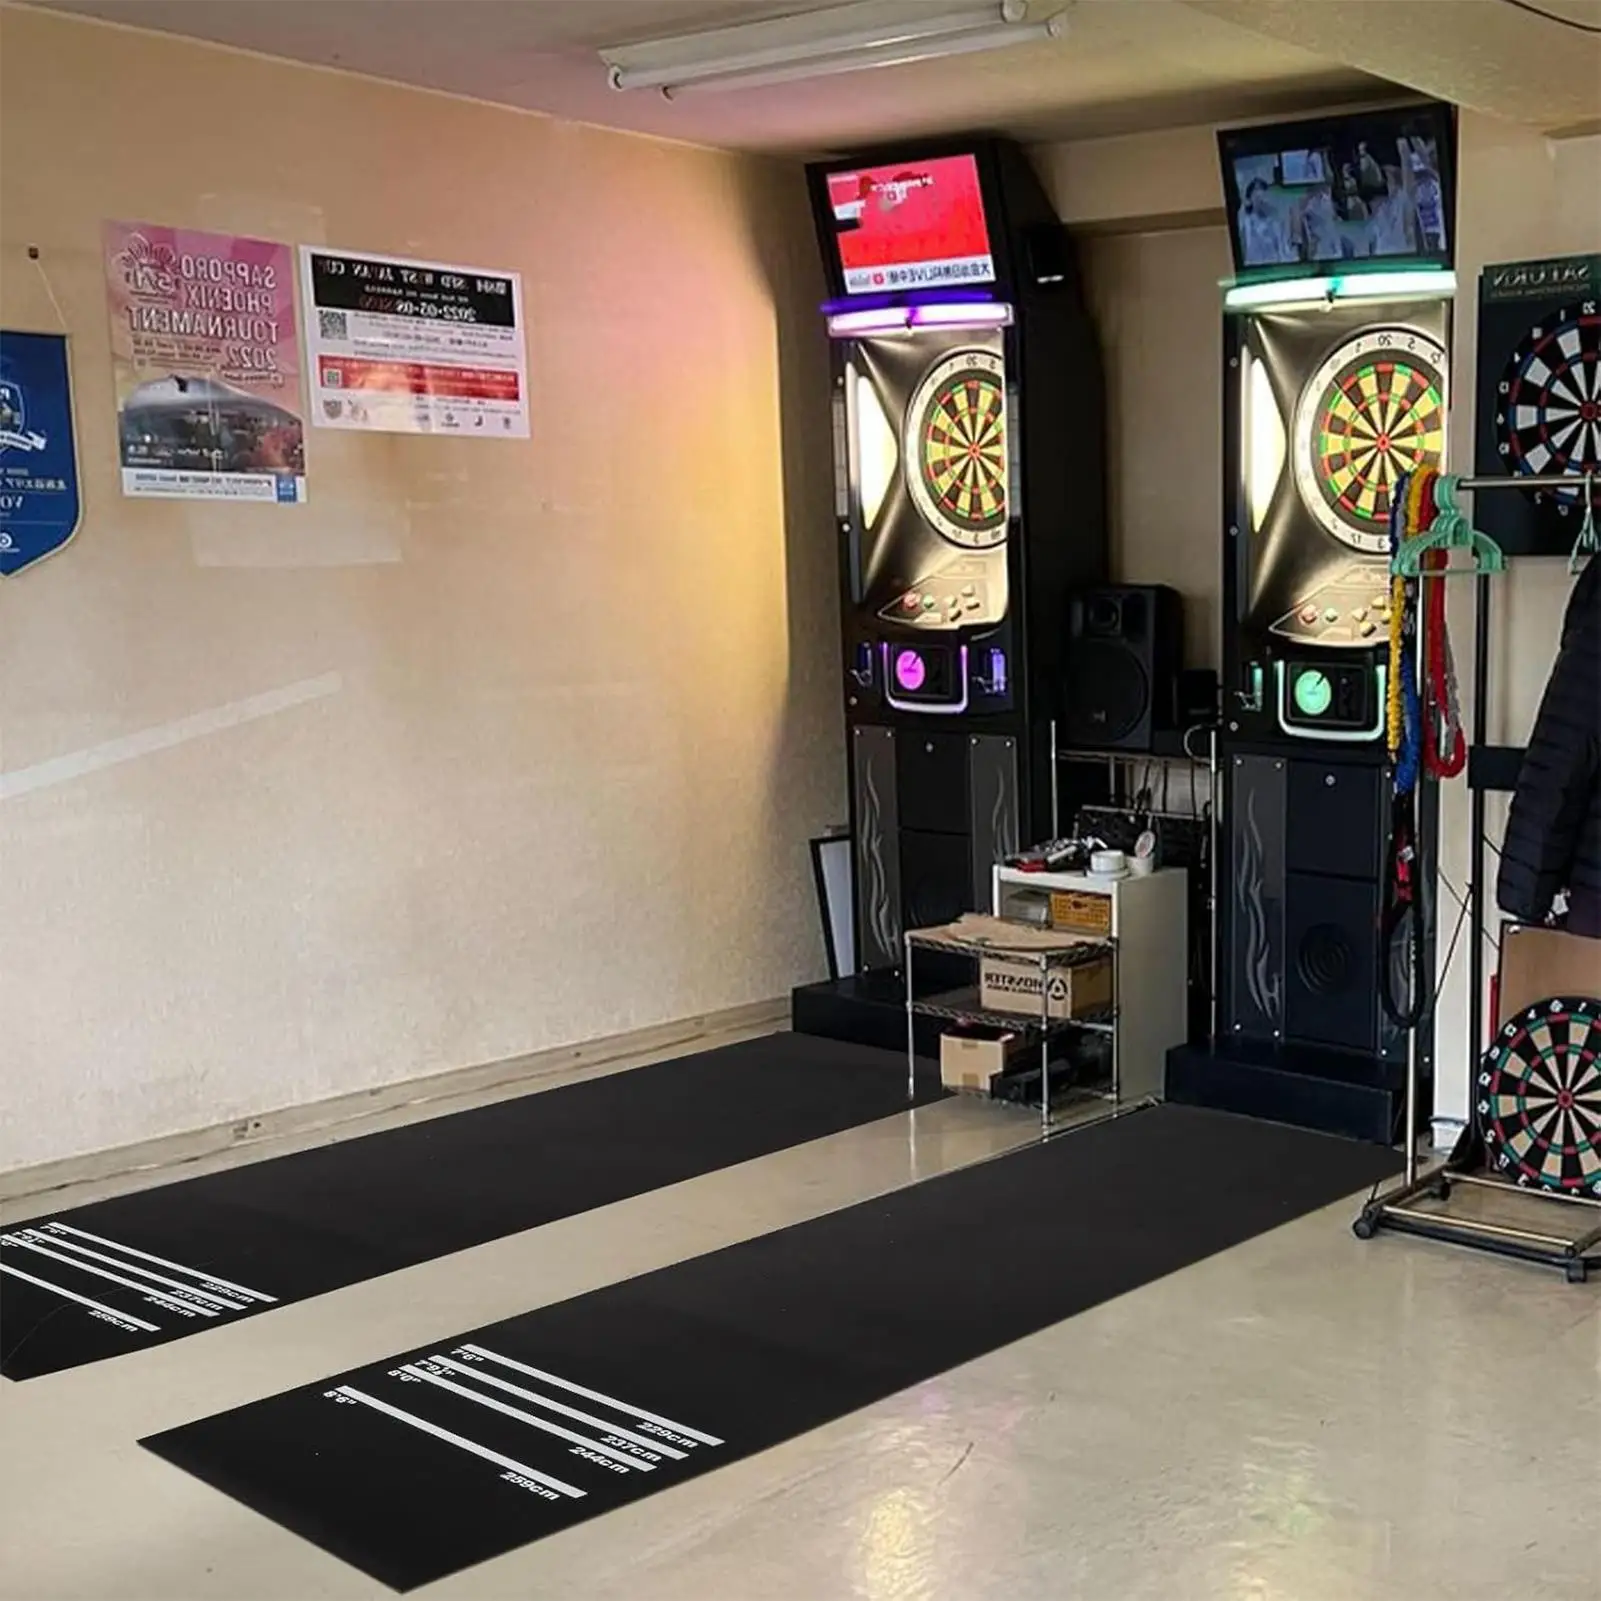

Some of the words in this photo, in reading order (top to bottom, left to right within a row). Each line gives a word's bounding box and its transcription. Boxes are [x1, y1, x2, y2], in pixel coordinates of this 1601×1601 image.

[170, 1289, 225, 1311] 237cm
[600, 1434, 662, 1462] 237cm
[635, 1421, 699, 1448] 229cm
[567, 1445, 631, 1474] 244cm
[499, 1471, 561, 1501] 259cm
